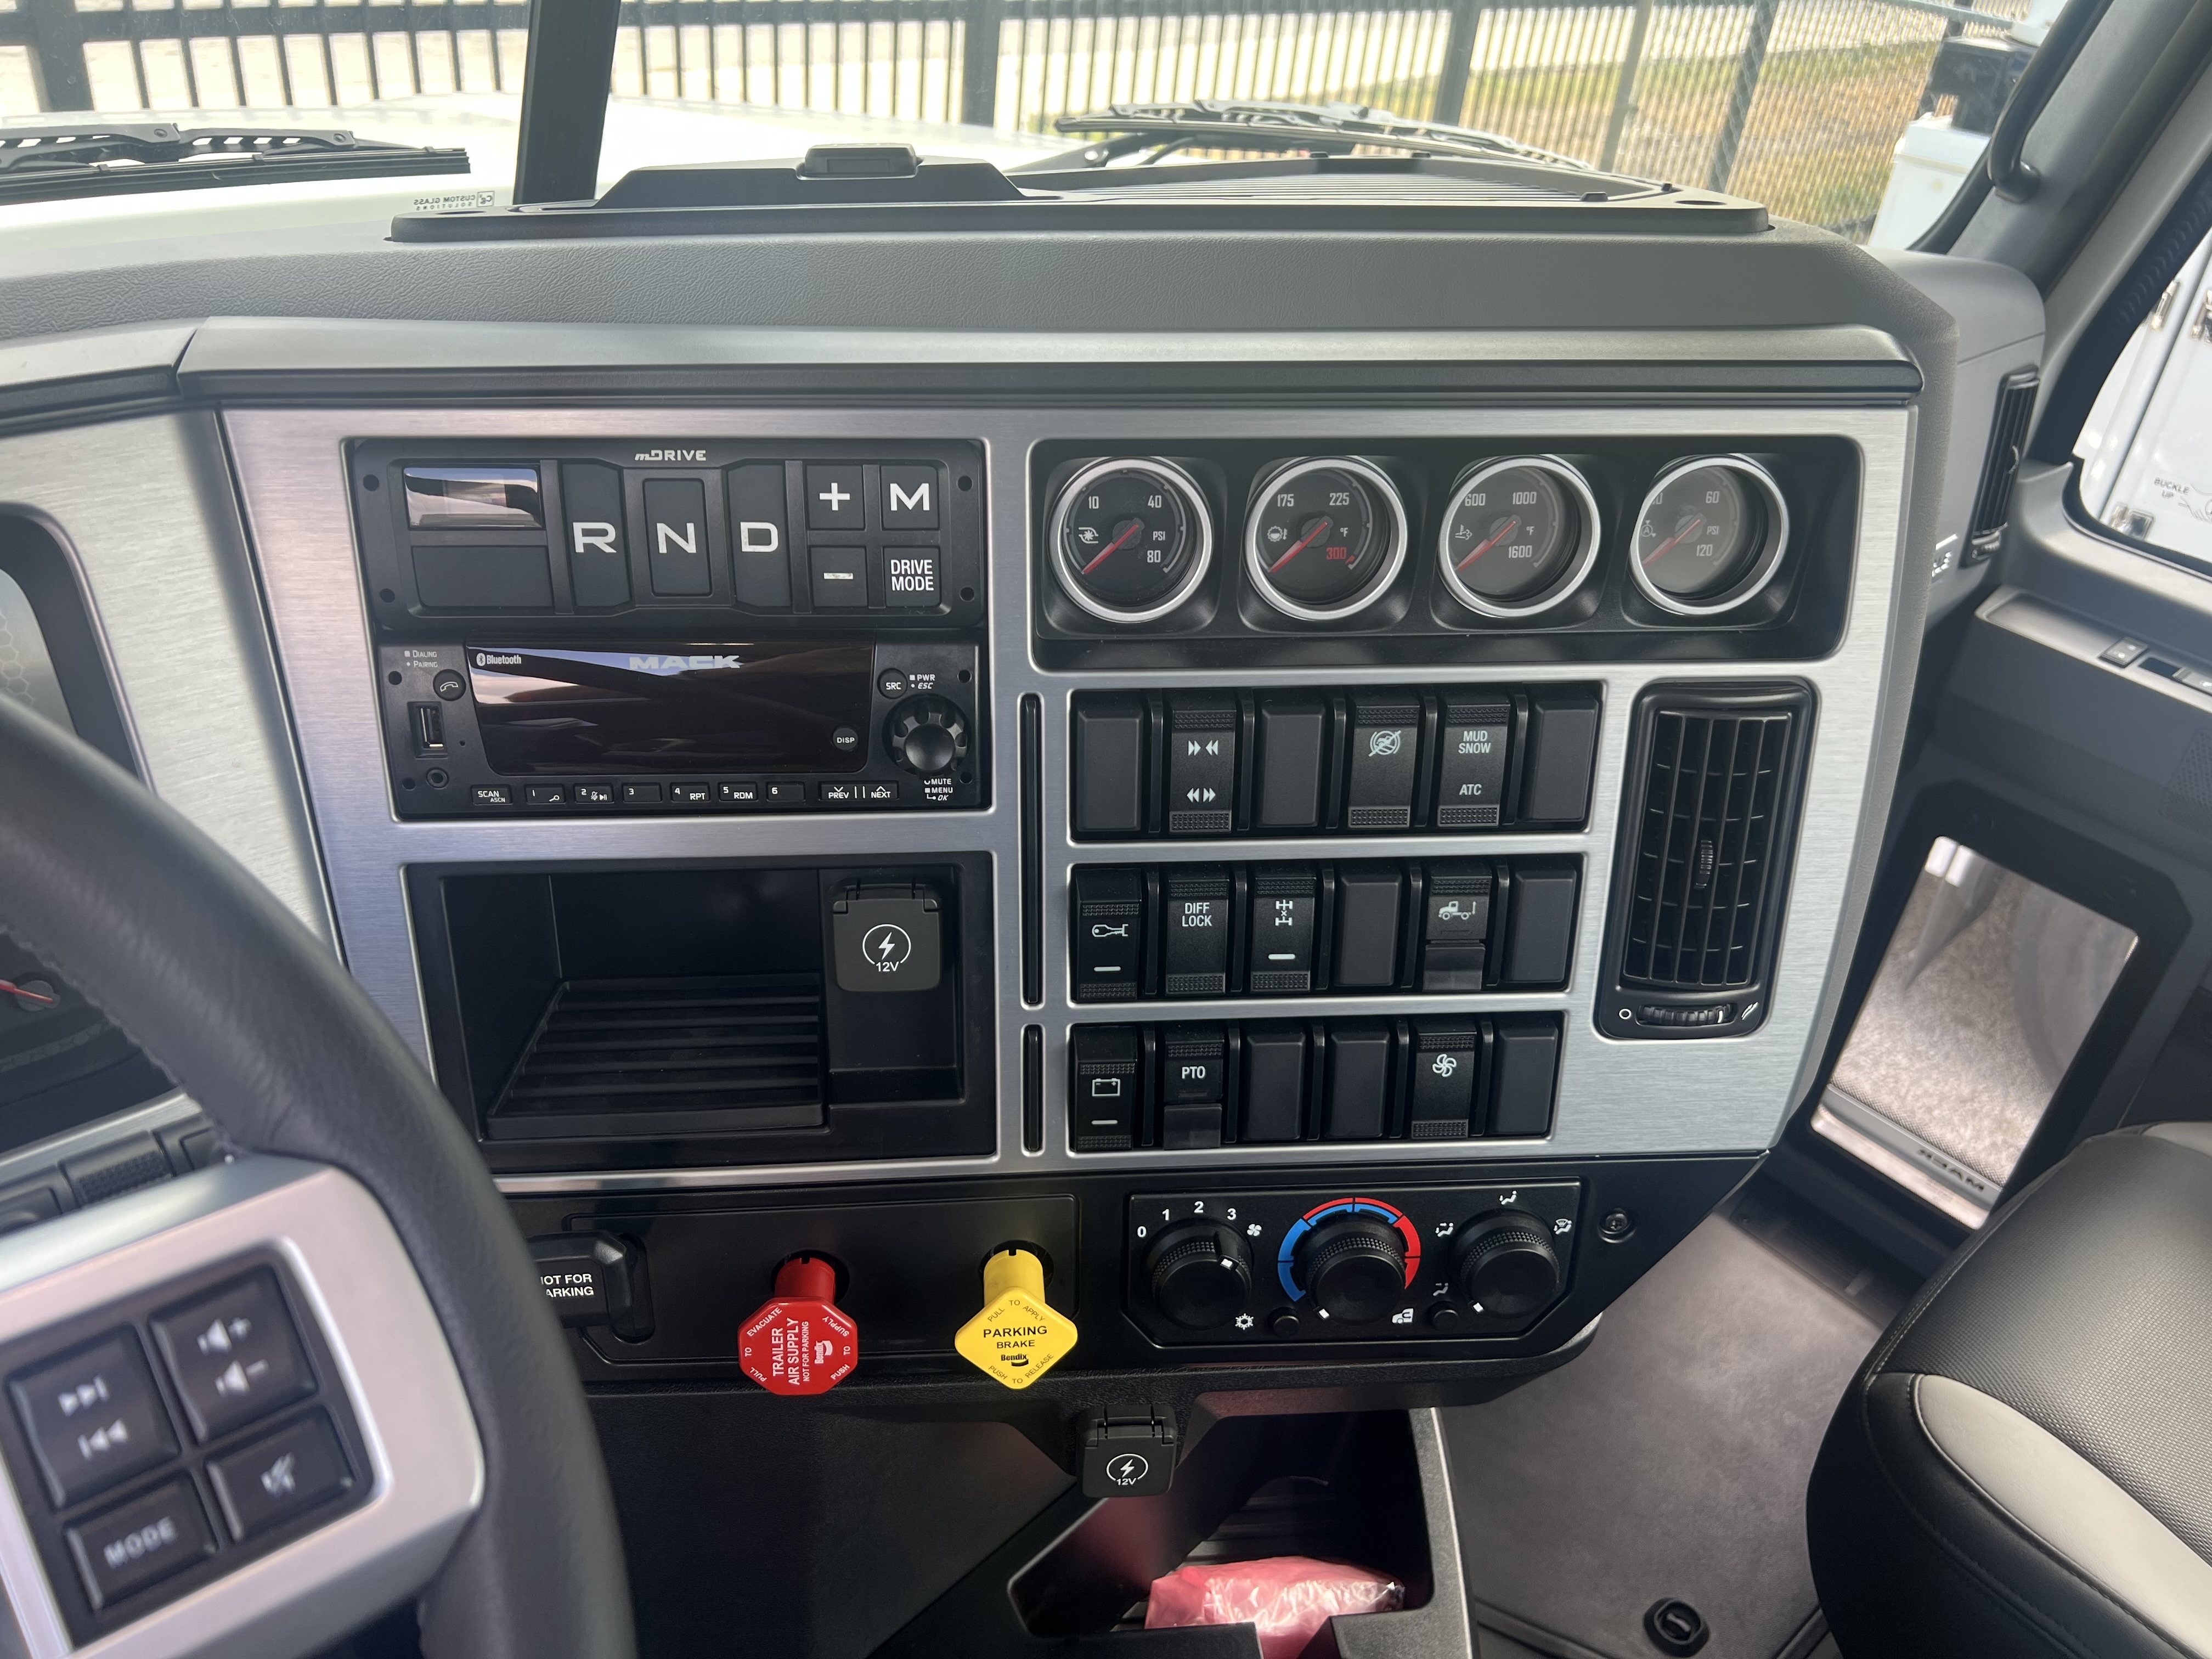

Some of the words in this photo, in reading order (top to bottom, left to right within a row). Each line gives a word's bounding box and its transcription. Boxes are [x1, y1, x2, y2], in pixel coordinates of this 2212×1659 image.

[634, 449, 707, 461] mDRIVE
[2153, 477, 2190, 495] BUCKLE
[889, 482, 930, 511] M
[1277, 493, 1295, 507] 175
[1329, 492, 1350, 506] 225
[1464, 493, 1486, 506] 600
[1512, 491, 1537, 505] 1000
[1705, 491, 1720, 504] 60
[2162, 490, 2175, 499] UP
[1088, 495, 1099, 510] 10
[1147, 495, 1163, 509] 40
[1153, 531, 1166, 541] PSI
[1707, 525, 1719, 535] PSI
[572, 522, 617, 554] R
[655, 522, 697, 554] N
[740, 521, 778, 553] D
[1147, 550, 1161, 563] 80
[1326, 546, 1347, 560] 300
[1508, 545, 1532, 558] 1600
[1696, 544, 1713, 557] 120
[890, 559, 933, 575] DRIVE
[891, 576, 934, 591] MODE
[486, 654, 522, 665] Bluetooth
[629, 655, 741, 669] MACK
[885, 681, 902, 690] SRC
[1463, 730, 1488, 742] MUD
[1458, 741, 1491, 754] SNOW
[690, 792, 706, 800] RPT
[1459, 783, 1482, 796] ATC
[1184, 902, 1210, 915] DIFF
[1182, 915, 1212, 928] LOCK
[876, 961, 900, 972] 12V
[1181, 1065, 1206, 1079] PTO
[1194, 1201, 1204, 1213] 2
[1162, 1209, 1170, 1220] 1
[1227, 1208, 1237, 1221] 3
[1137, 1226, 1147, 1238] 0
[565, 1273, 592, 1284] FOR
[546, 1286, 594, 1297] ARKING
[987, 1307, 1006, 1322] PULL
[1022, 1305, 1046, 1322] APPLY
[746, 1307, 782, 1337] EVACUATE
[822, 1316, 850, 1337] SUPPLY
[983, 1325, 1047, 1338] PARKING
[787, 1317, 799, 1364] SUPPLY
[996, 1339, 1036, 1349] BRAKE
[744, 1347, 752, 1357] TO
[771, 1328, 784, 1377] TRAILER
[843, 1346, 850, 1356] TO
[830, 1364, 850, 1380] PUSH
[988, 1365, 1008, 1380] PUSH
[1025, 1353, 1054, 1378] RELEASE
[750, 1367, 768, 1383] PULL
[788, 1367, 800, 1385] AIR
[1116, 1477, 1137, 1486] 12V
[103, 1516, 178, 1568] MODE
